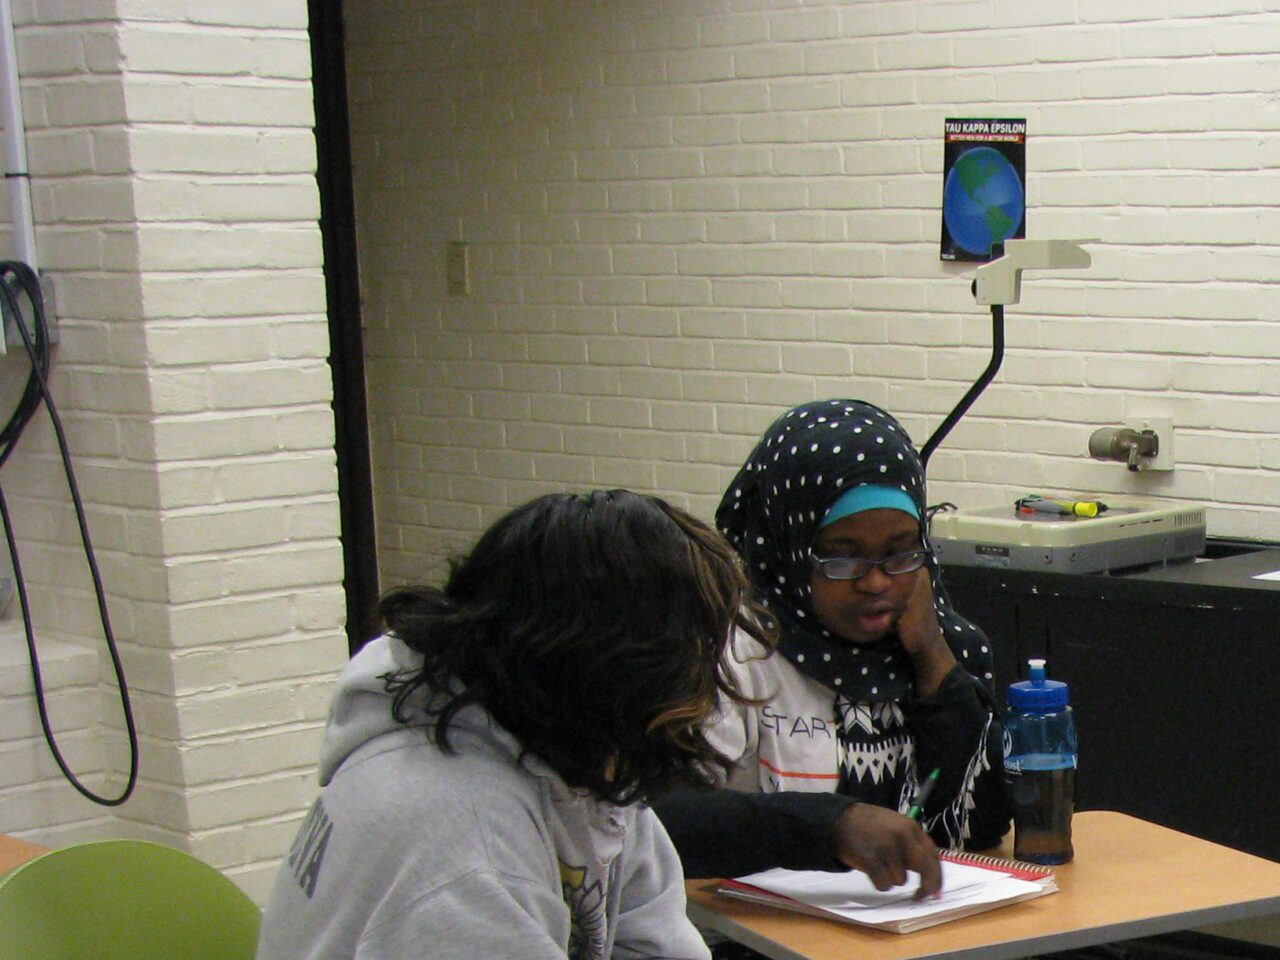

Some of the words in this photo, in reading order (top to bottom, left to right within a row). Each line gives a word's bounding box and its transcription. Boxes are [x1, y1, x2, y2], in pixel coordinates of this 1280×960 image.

[945, 123, 961, 133] TAU
[963, 123, 989, 133] KAPPA
[990, 123, 1025, 134] EPSILON
[760, 705, 832, 739] STAR
